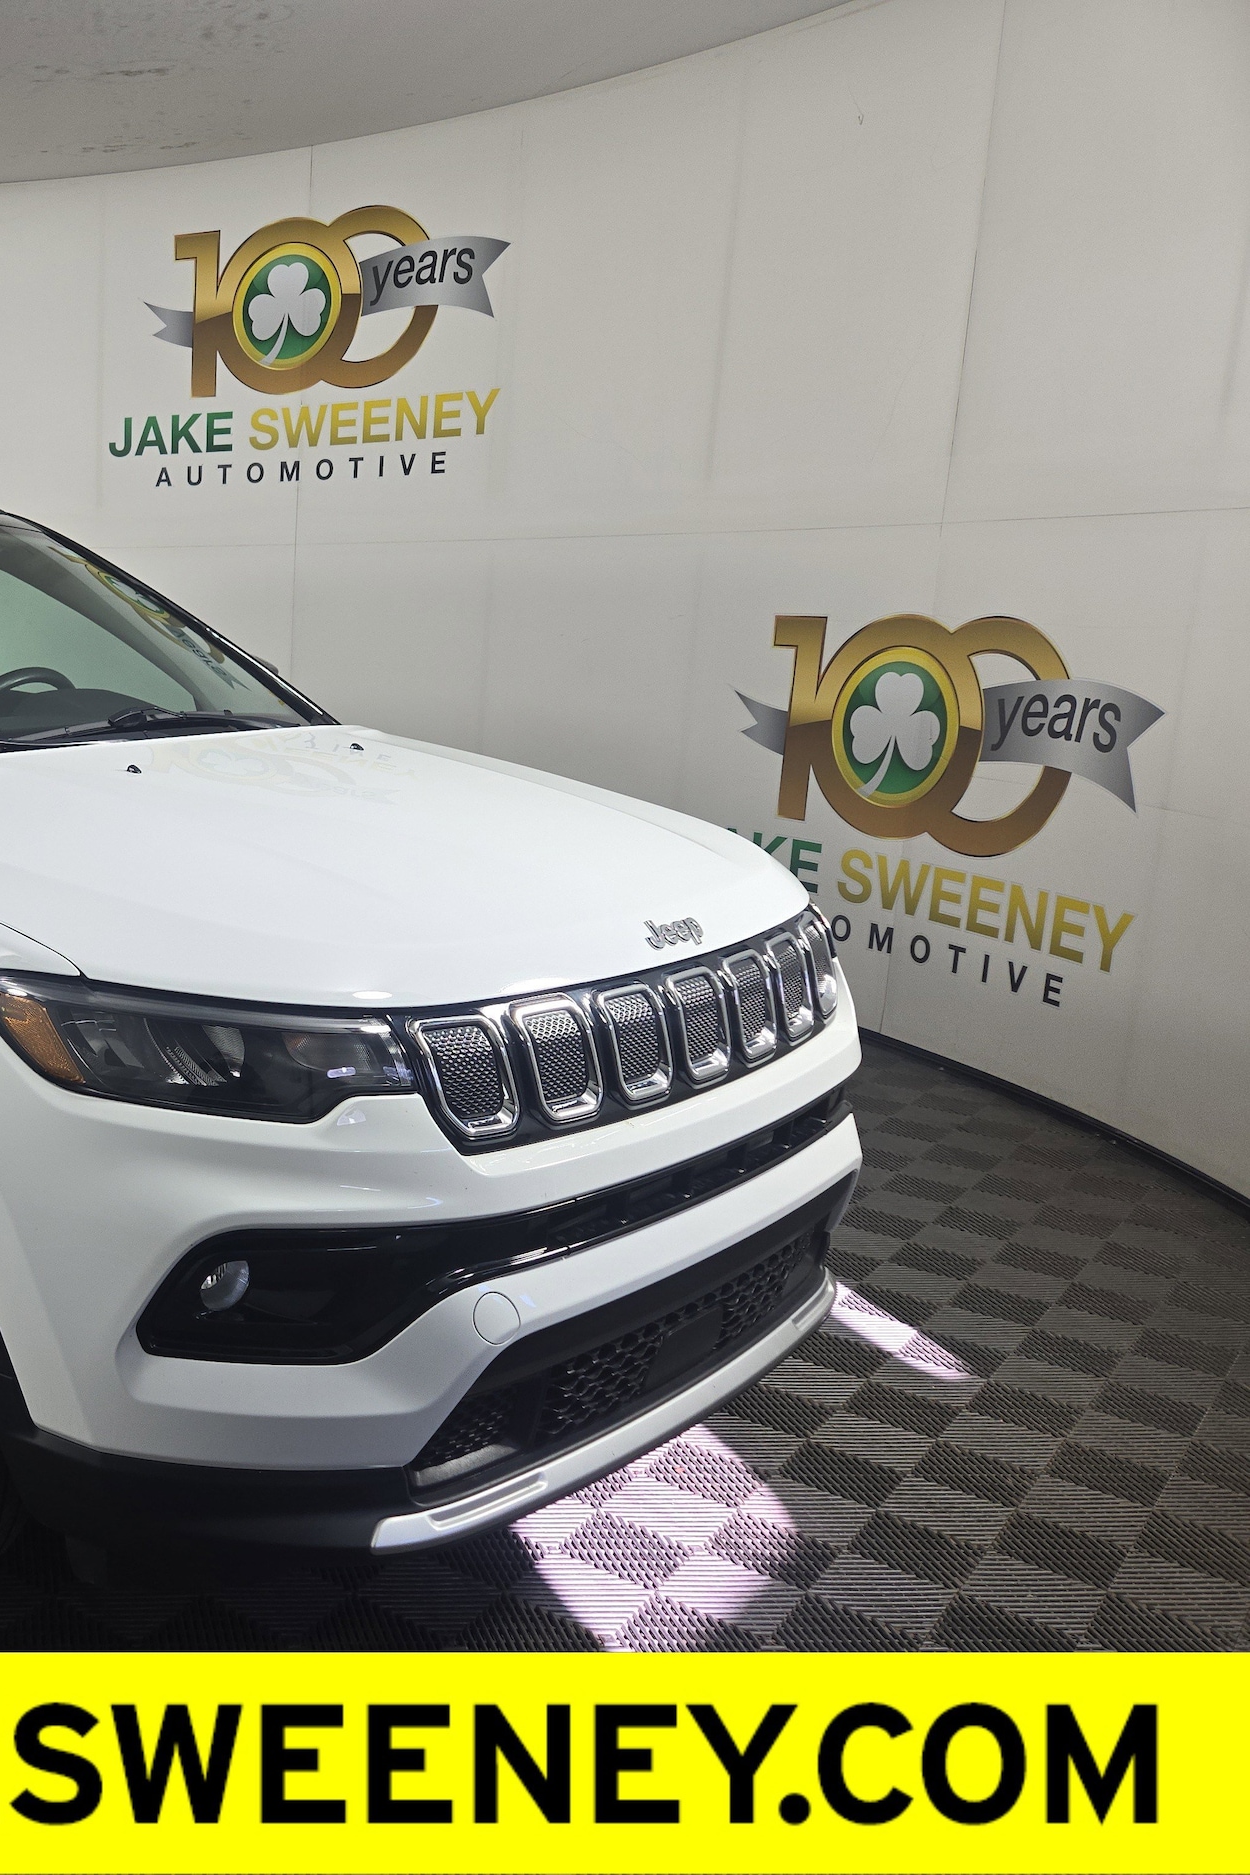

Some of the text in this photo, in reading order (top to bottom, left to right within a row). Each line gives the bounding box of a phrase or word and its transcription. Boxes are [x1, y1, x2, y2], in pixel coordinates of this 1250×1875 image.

[174, 205, 476, 398] 100 years
[109, 388, 501, 458] JAKE SWEENEY
[155, 451, 447, 487] AUTOMOTIVE
[773, 614, 1122, 858] 100 years
[643, 917, 704, 951] Jeep
[837, 848, 1135, 973] SWEENEY
[831, 914, 1064, 1007] OMOTIVE
